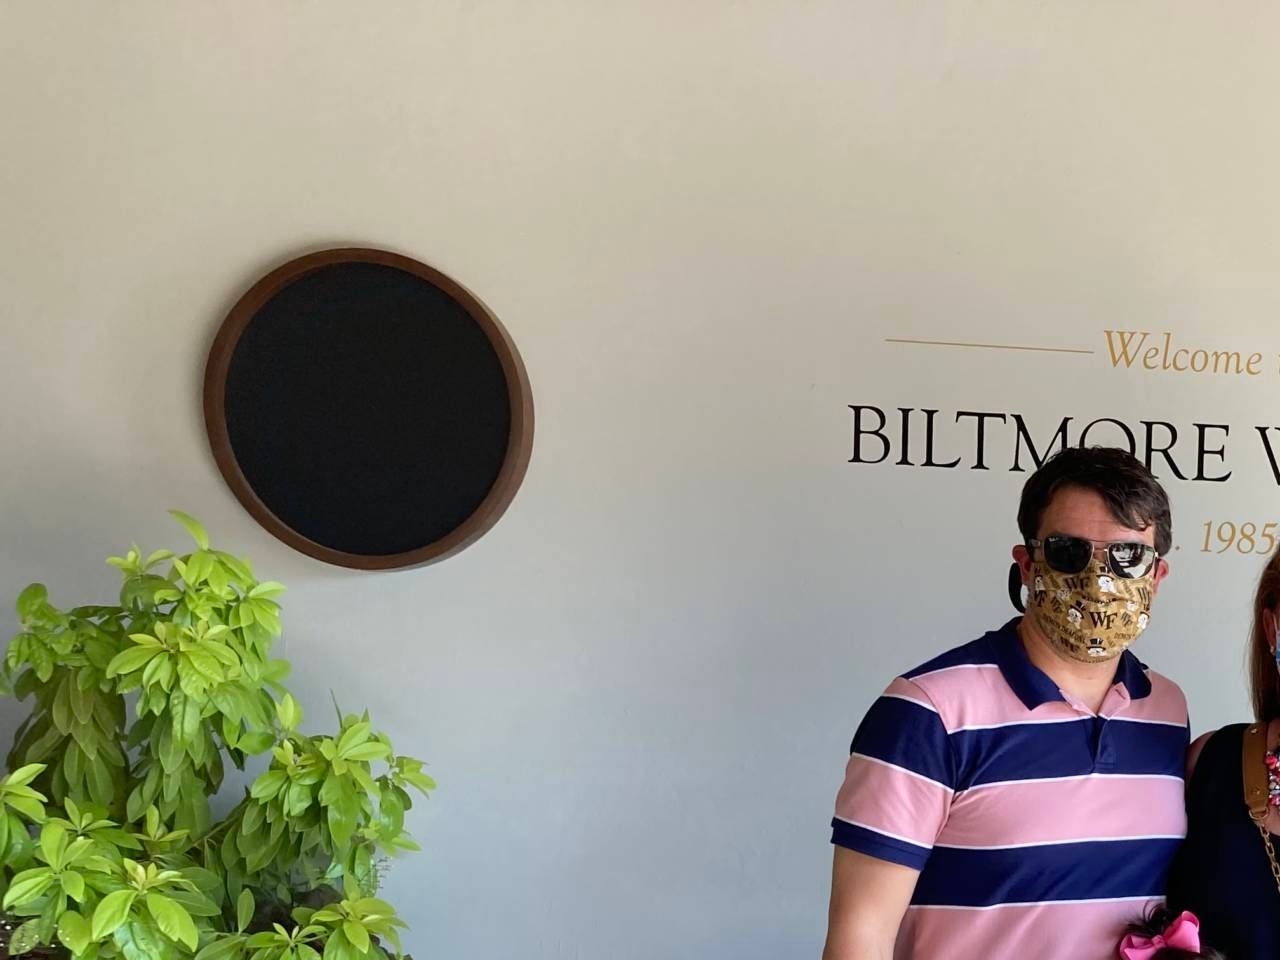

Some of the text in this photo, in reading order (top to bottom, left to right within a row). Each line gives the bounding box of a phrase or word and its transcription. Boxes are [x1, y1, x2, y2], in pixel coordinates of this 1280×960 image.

[1103, 329, 1263, 376] Welcome
[847, 403, 1233, 482] BILTMORE
[1200, 519, 1279, 555] 1985
[1089, 611, 1118, 630] WF
